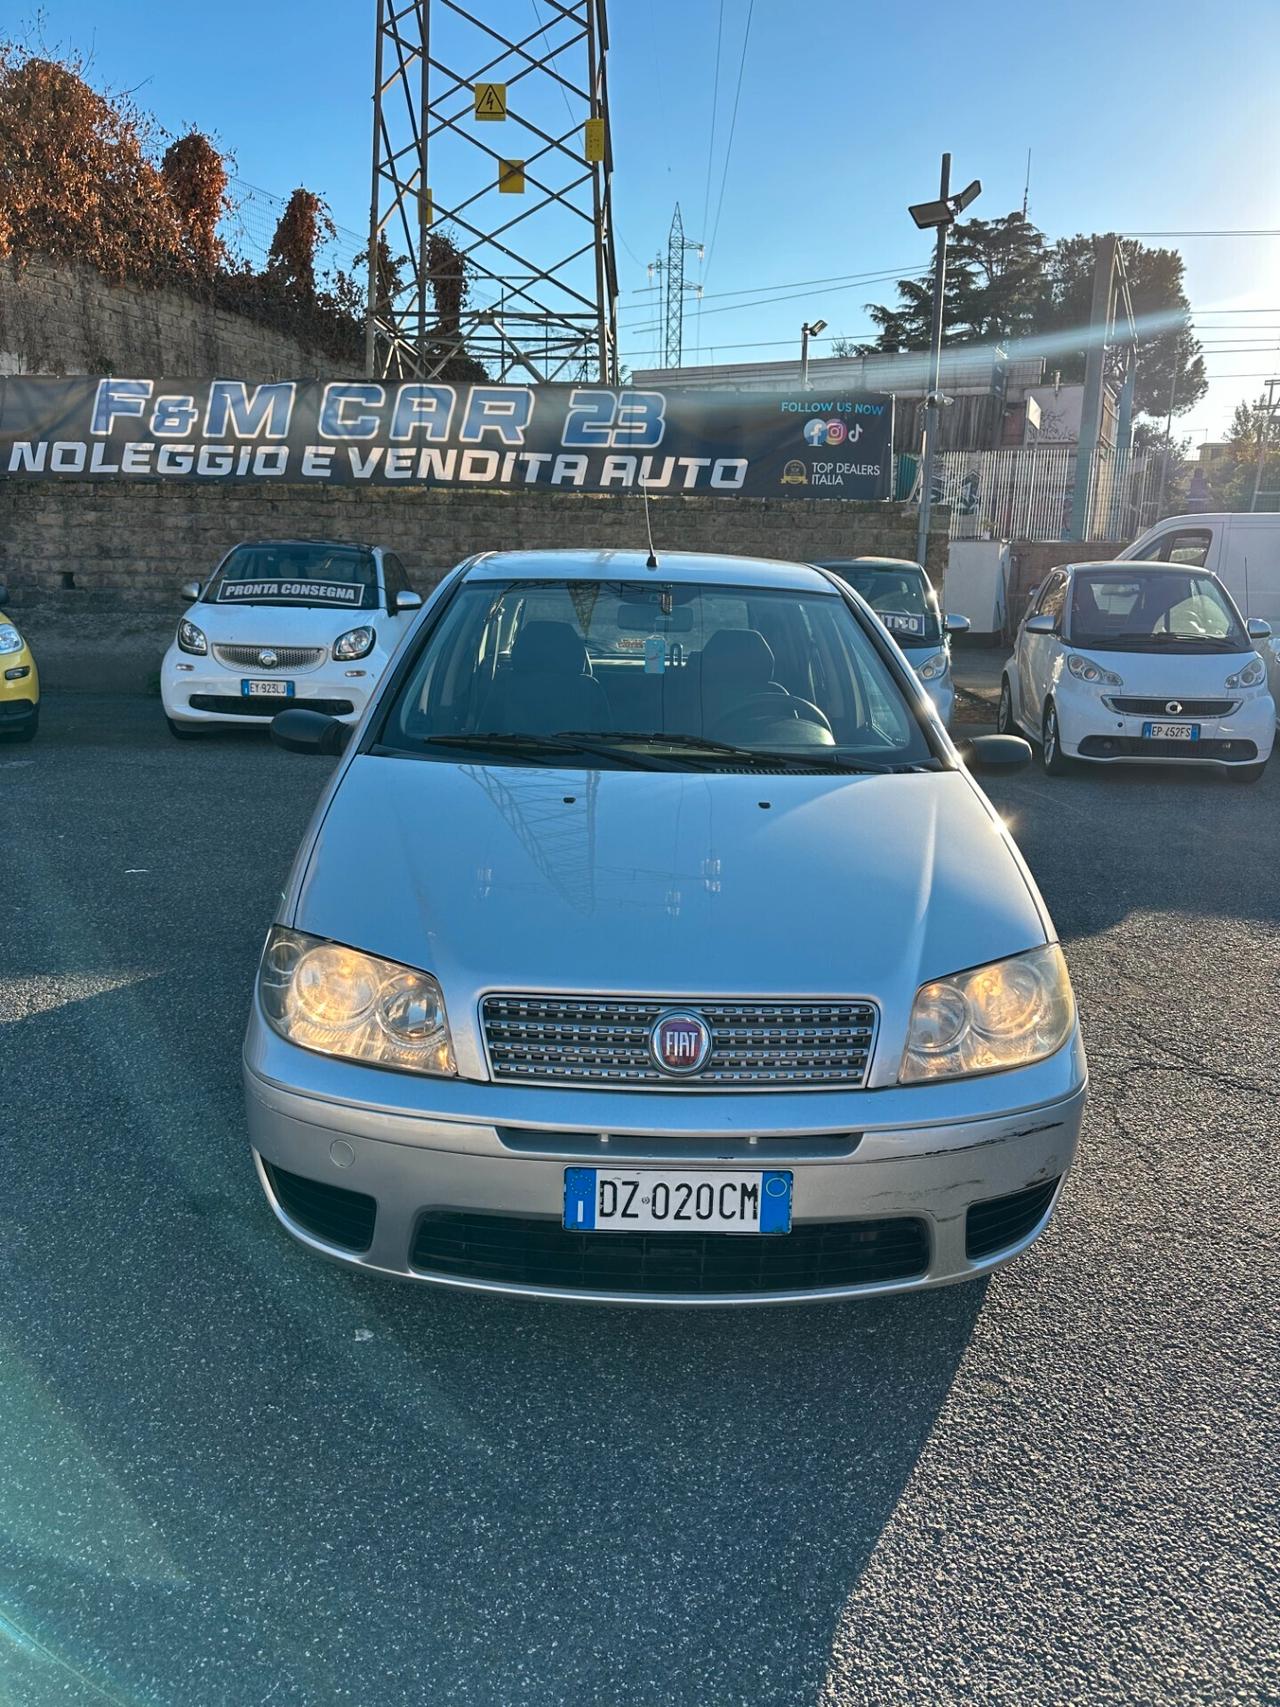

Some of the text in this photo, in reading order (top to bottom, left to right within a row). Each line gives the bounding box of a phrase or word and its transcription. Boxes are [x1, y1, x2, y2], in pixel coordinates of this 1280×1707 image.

[90, 378, 666, 448] F&M CAR 23
[781, 401, 884, 415] FOLLOW US NOW
[8, 441, 749, 489] NOLEGGIO E VENDITA AUTO
[812, 462, 880, 476] TOP DEALERS
[811, 474, 844, 485] ITALIA
[225, 583, 355, 599] PRONTA CONSEGNA
[665, 1031, 698, 1057] FIAT
